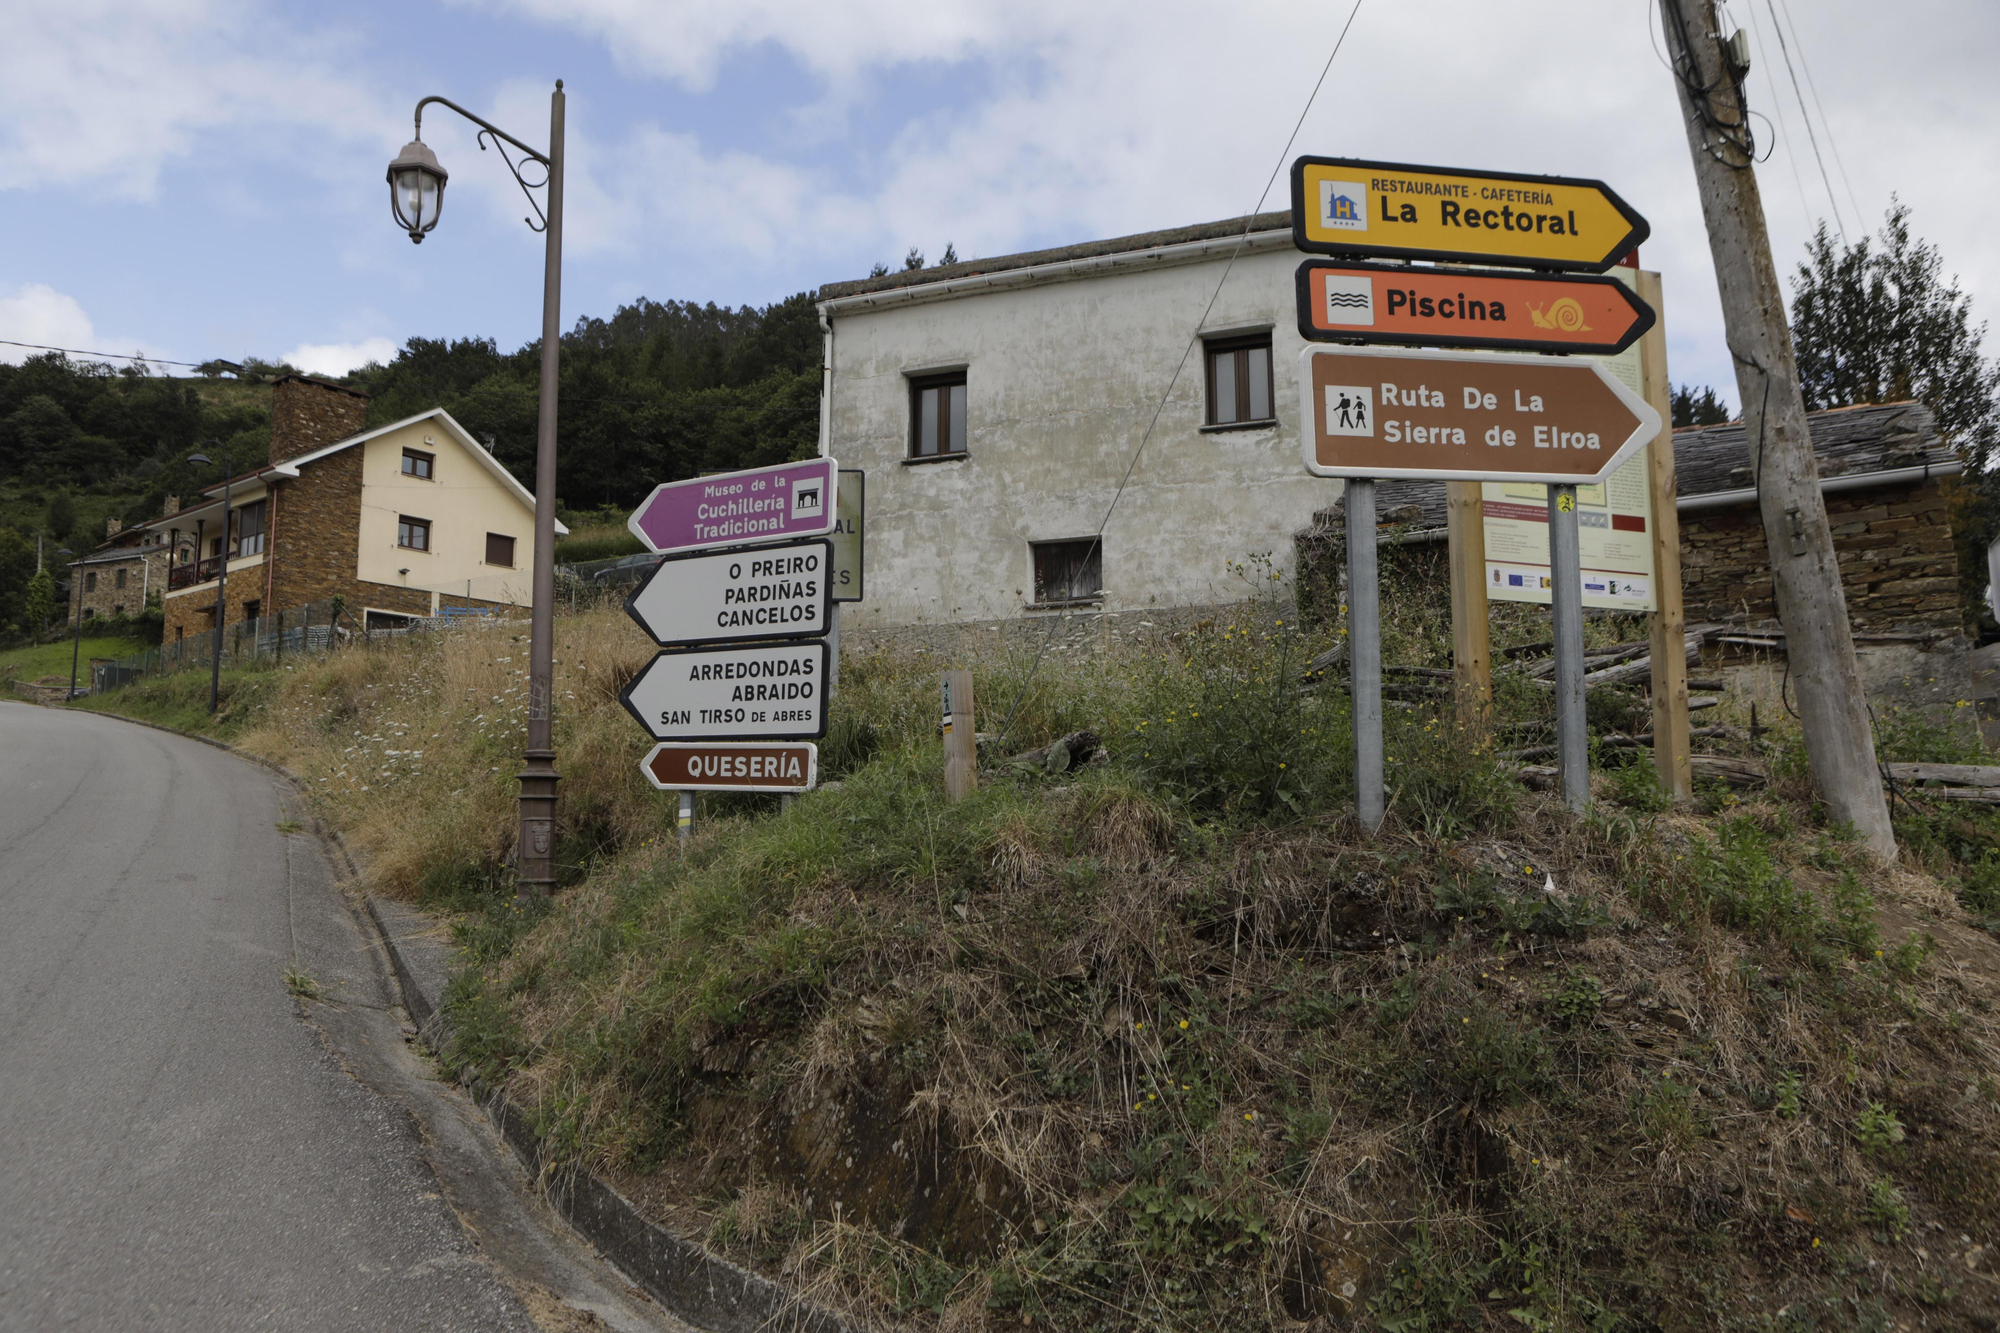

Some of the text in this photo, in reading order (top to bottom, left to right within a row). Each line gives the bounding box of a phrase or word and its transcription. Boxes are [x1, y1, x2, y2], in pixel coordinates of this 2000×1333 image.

[1371, 178, 1469, 198] RESTAURANTE
[1481, 187, 1553, 205] CAFETERÍA
[1380, 195, 1579, 236] La Rectoral
[1387, 289, 1506, 322] Piscina
[1381, 382, 1544, 412] Ruta De La
[1383, 420, 1601, 450] Sierra de Elroa
[704, 476, 786, 499] Museo de la
[697, 494, 785, 520] Cuchillería
[694, 513, 785, 540] Tradicional
[729, 555, 818, 580] O PREIRO
[725, 579, 817, 605] PARDIÑAS
[717, 604, 816, 628] CANCELOS
[689, 658, 814, 681] ARREDONDAS
[731, 682, 814, 702] ABRAIDO
[660, 708, 812, 725] SAN TIRSO DE ABRES
[687, 752, 802, 778] QUESERÍA
